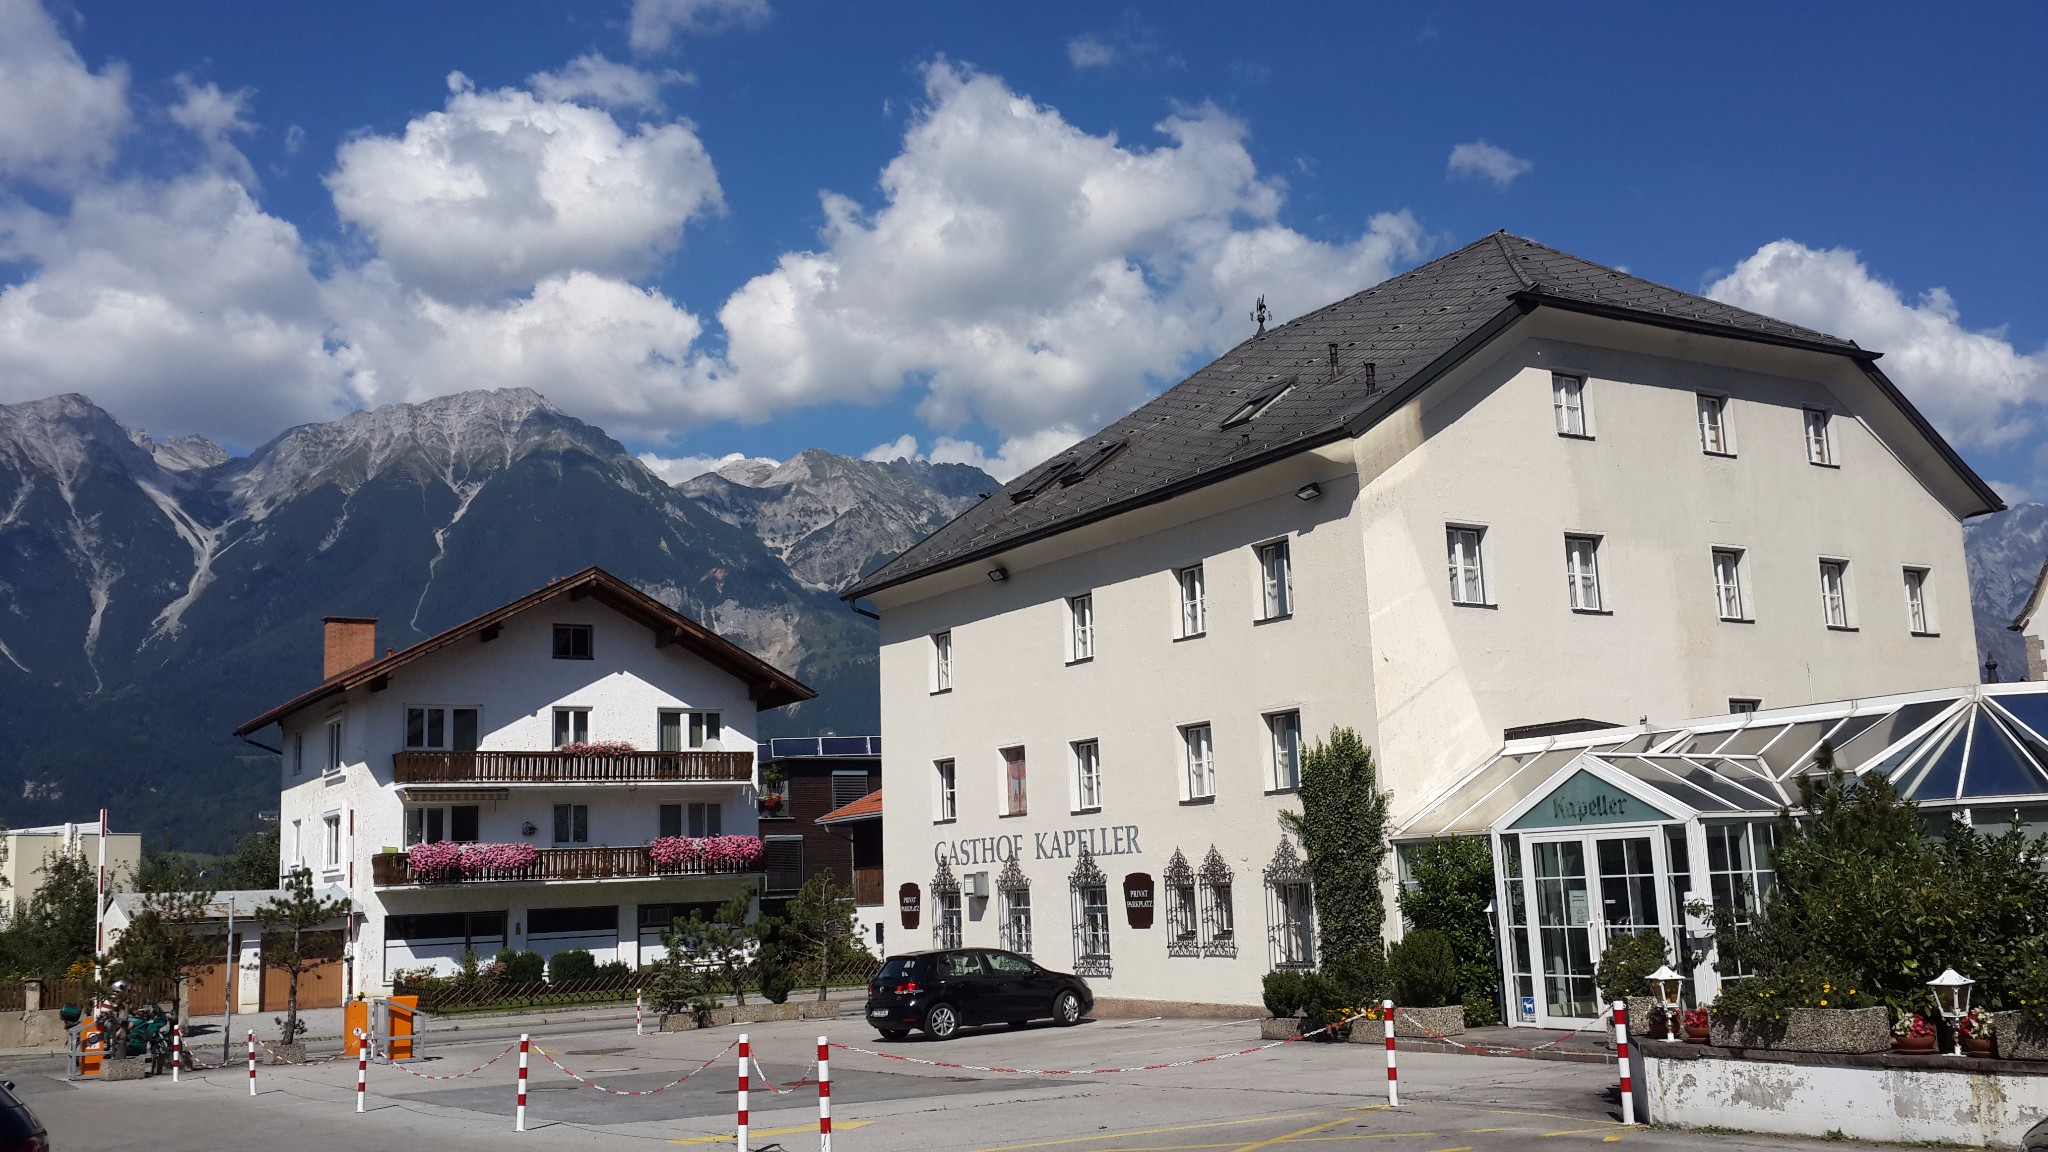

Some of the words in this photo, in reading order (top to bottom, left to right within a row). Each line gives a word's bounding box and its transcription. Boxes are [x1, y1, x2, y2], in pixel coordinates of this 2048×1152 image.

[1553, 795, 1627, 822] Kapeller
[934, 834, 1023, 866] GASTHOF
[1034, 825, 1142, 859] KAPELLER
[1130, 890, 1148, 898] PRIVAT
[1126, 900, 1153, 908] PARKPLATZ
